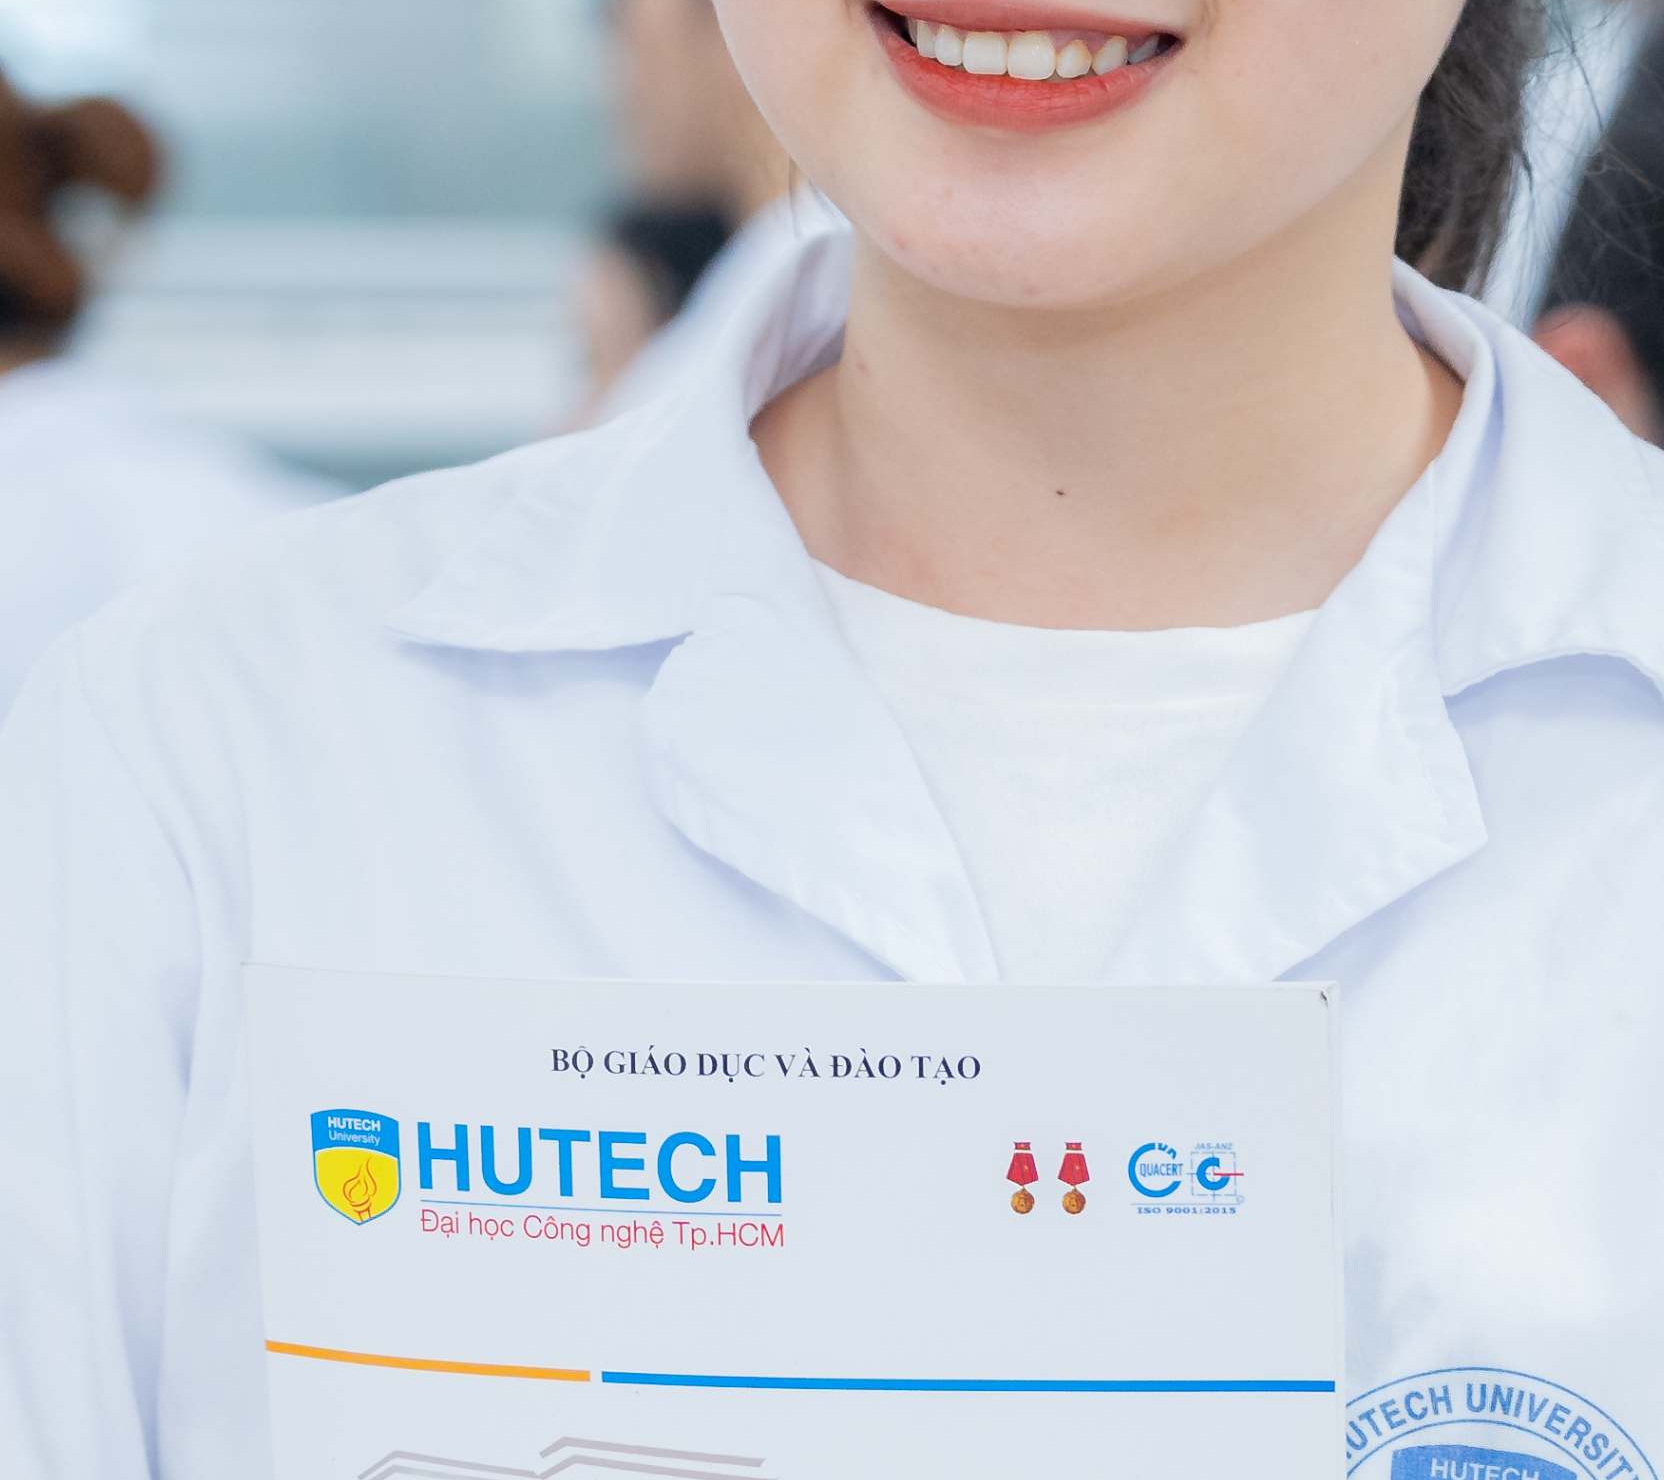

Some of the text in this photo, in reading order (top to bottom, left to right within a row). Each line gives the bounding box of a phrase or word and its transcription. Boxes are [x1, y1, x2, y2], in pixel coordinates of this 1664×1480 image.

[550, 1044, 981, 1086] BỘ GIÁO DỤC VÀ ĐÀO TẠO
[327, 1115, 381, 1132] HUTECH
[328, 1131, 381, 1146] University
[417, 1121, 782, 1204] HUTECH
[1139, 1163, 1184, 1177] QUACERT
[1137, 1206, 1162, 1214] ISO
[419, 1208, 784, 1251] Đại học Công nghệ Tp.HCM
[1346, 1384, 1453, 1459] UTECH
